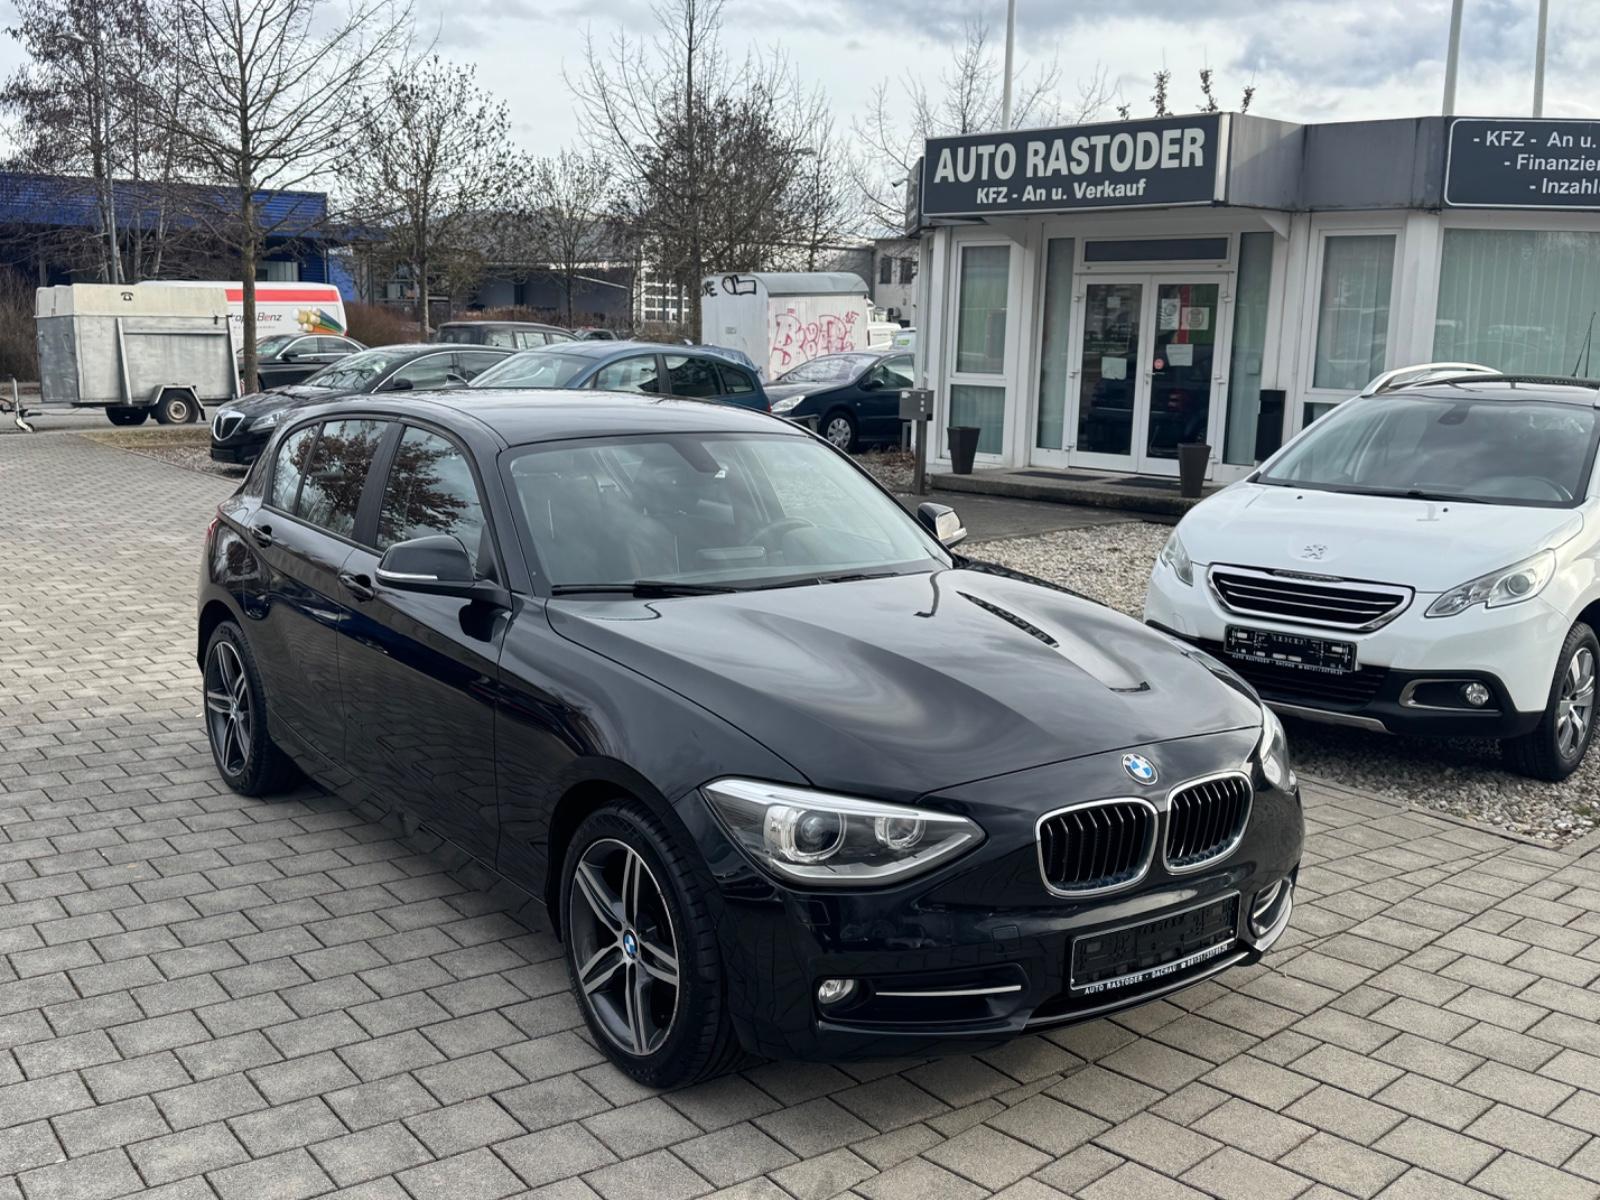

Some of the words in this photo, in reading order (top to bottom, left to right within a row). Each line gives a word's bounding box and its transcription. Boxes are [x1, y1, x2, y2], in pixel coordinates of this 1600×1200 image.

[1486, 130, 1525, 147] KFZ
[1546, 131, 1573, 147] An
[1580, 136, 1597, 148] u.
[933, 142, 1017, 184] AUTO
[1025, 127, 1206, 178] RASTODER
[976, 186, 1008, 204] KFZ
[1022, 184, 1046, 202] An
[1051, 187, 1067, 201] u.
[1073, 179, 1147, 199] Verkauf
[1542, 178, 1600, 195] Inzahl
[257, 311, 282, 322] Benz
[1084, 984, 1105, 995] AUTO
[1106, 975, 1143, 990] RASTODER
